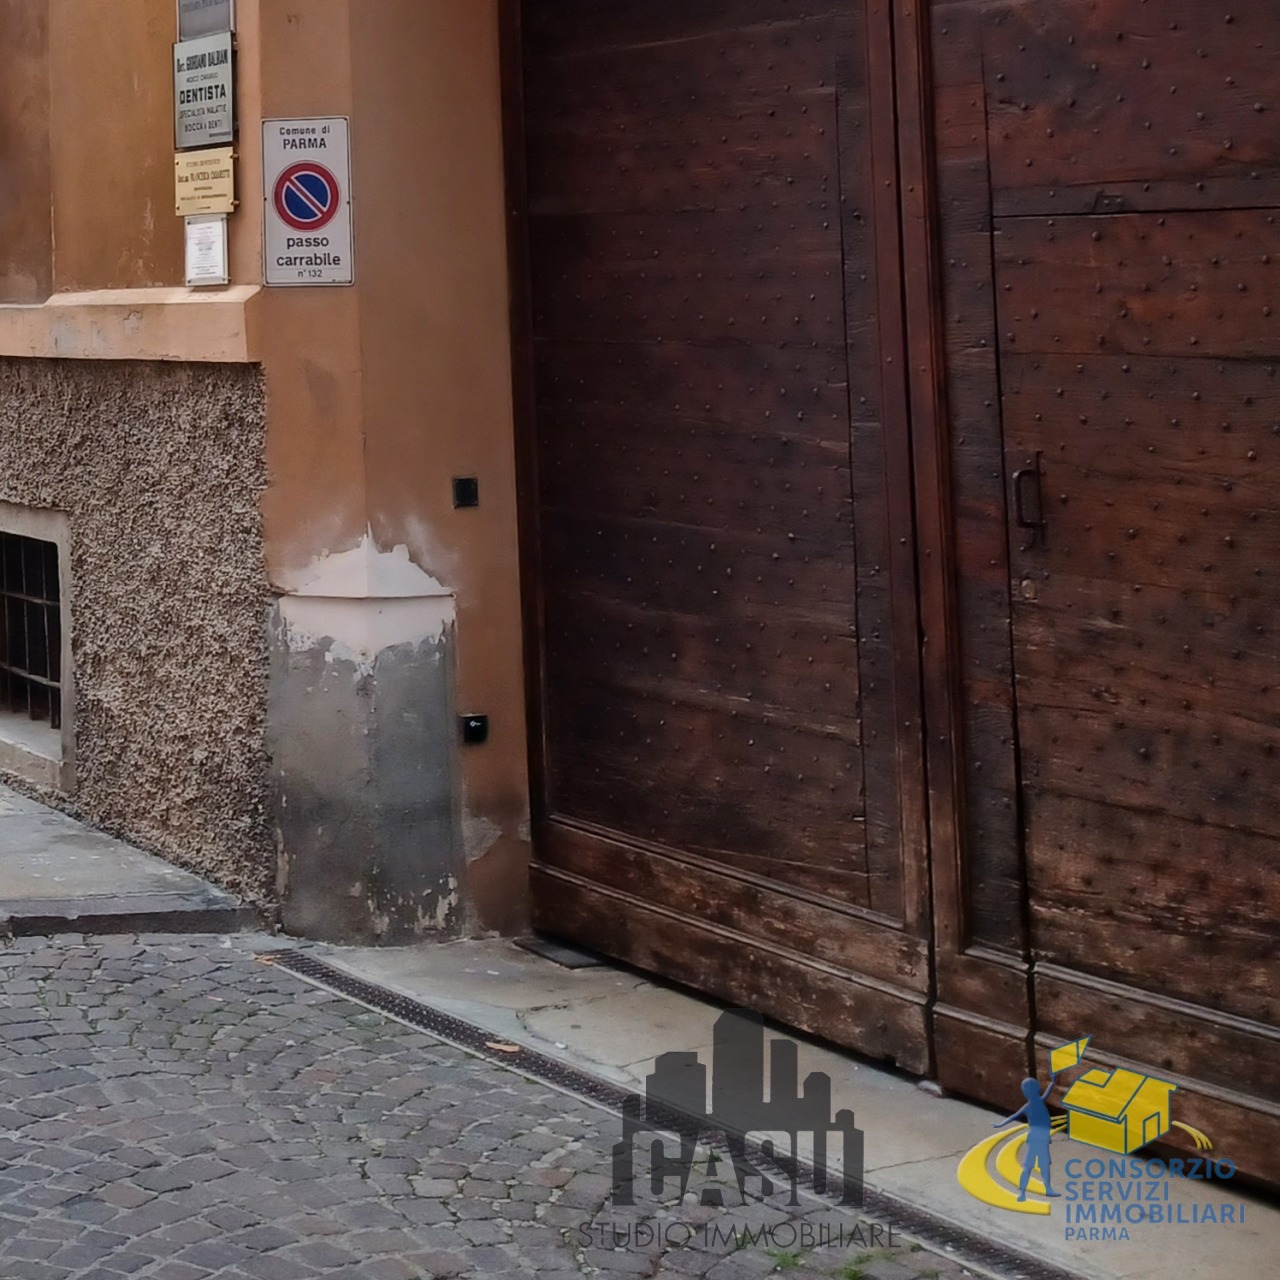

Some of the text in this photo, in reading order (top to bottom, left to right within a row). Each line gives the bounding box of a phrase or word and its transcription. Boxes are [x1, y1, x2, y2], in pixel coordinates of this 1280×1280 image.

[179, 83, 227, 105] DENTISTA
[185, 122, 203, 132] BOCCA
[279, 125, 331, 136] Comune di
[283, 138, 327, 150] PARMA
[286, 235, 330, 249] passo
[276, 252, 341, 267] carrabile
